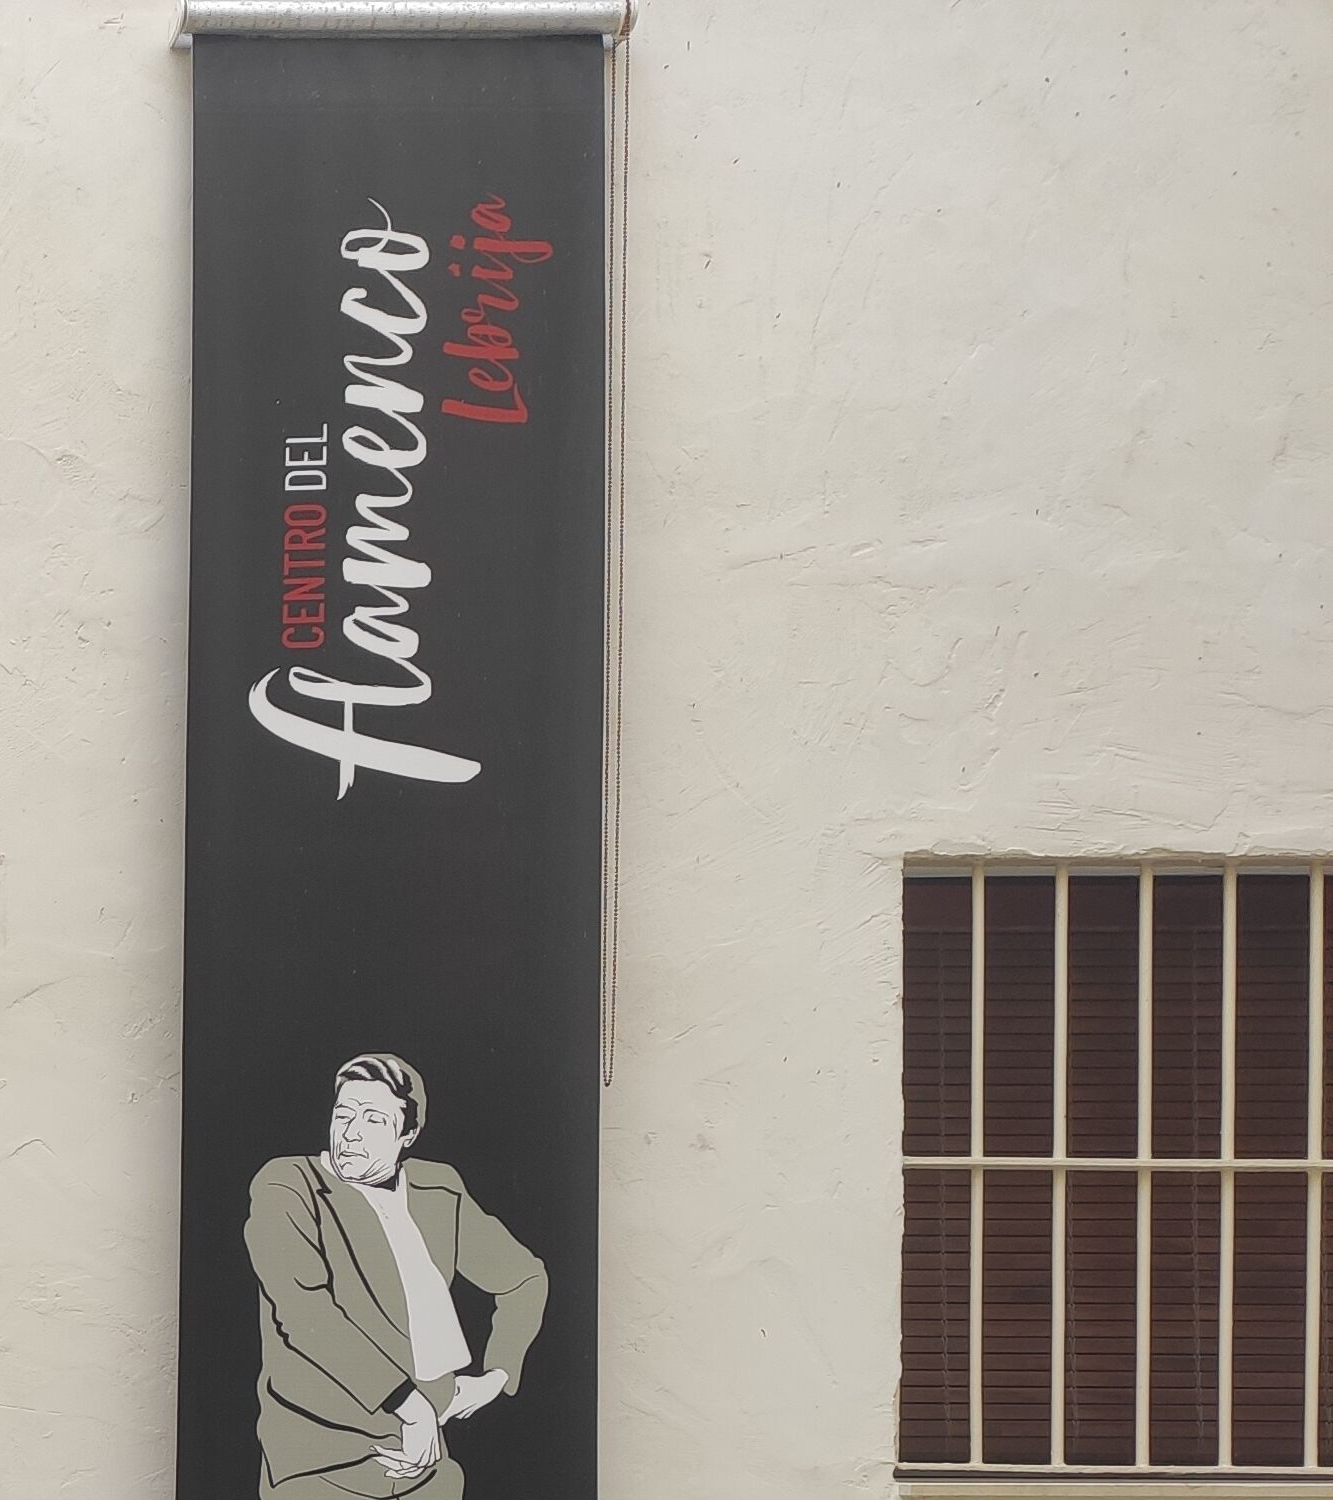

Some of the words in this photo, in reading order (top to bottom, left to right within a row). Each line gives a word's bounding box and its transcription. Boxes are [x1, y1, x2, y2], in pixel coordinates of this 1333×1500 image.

[441, 192, 553, 424] Lebrija
[248, 197, 482, 800] flamenco
[284, 422, 328, 491] DEL
[282, 503, 327, 650] CENTRO
